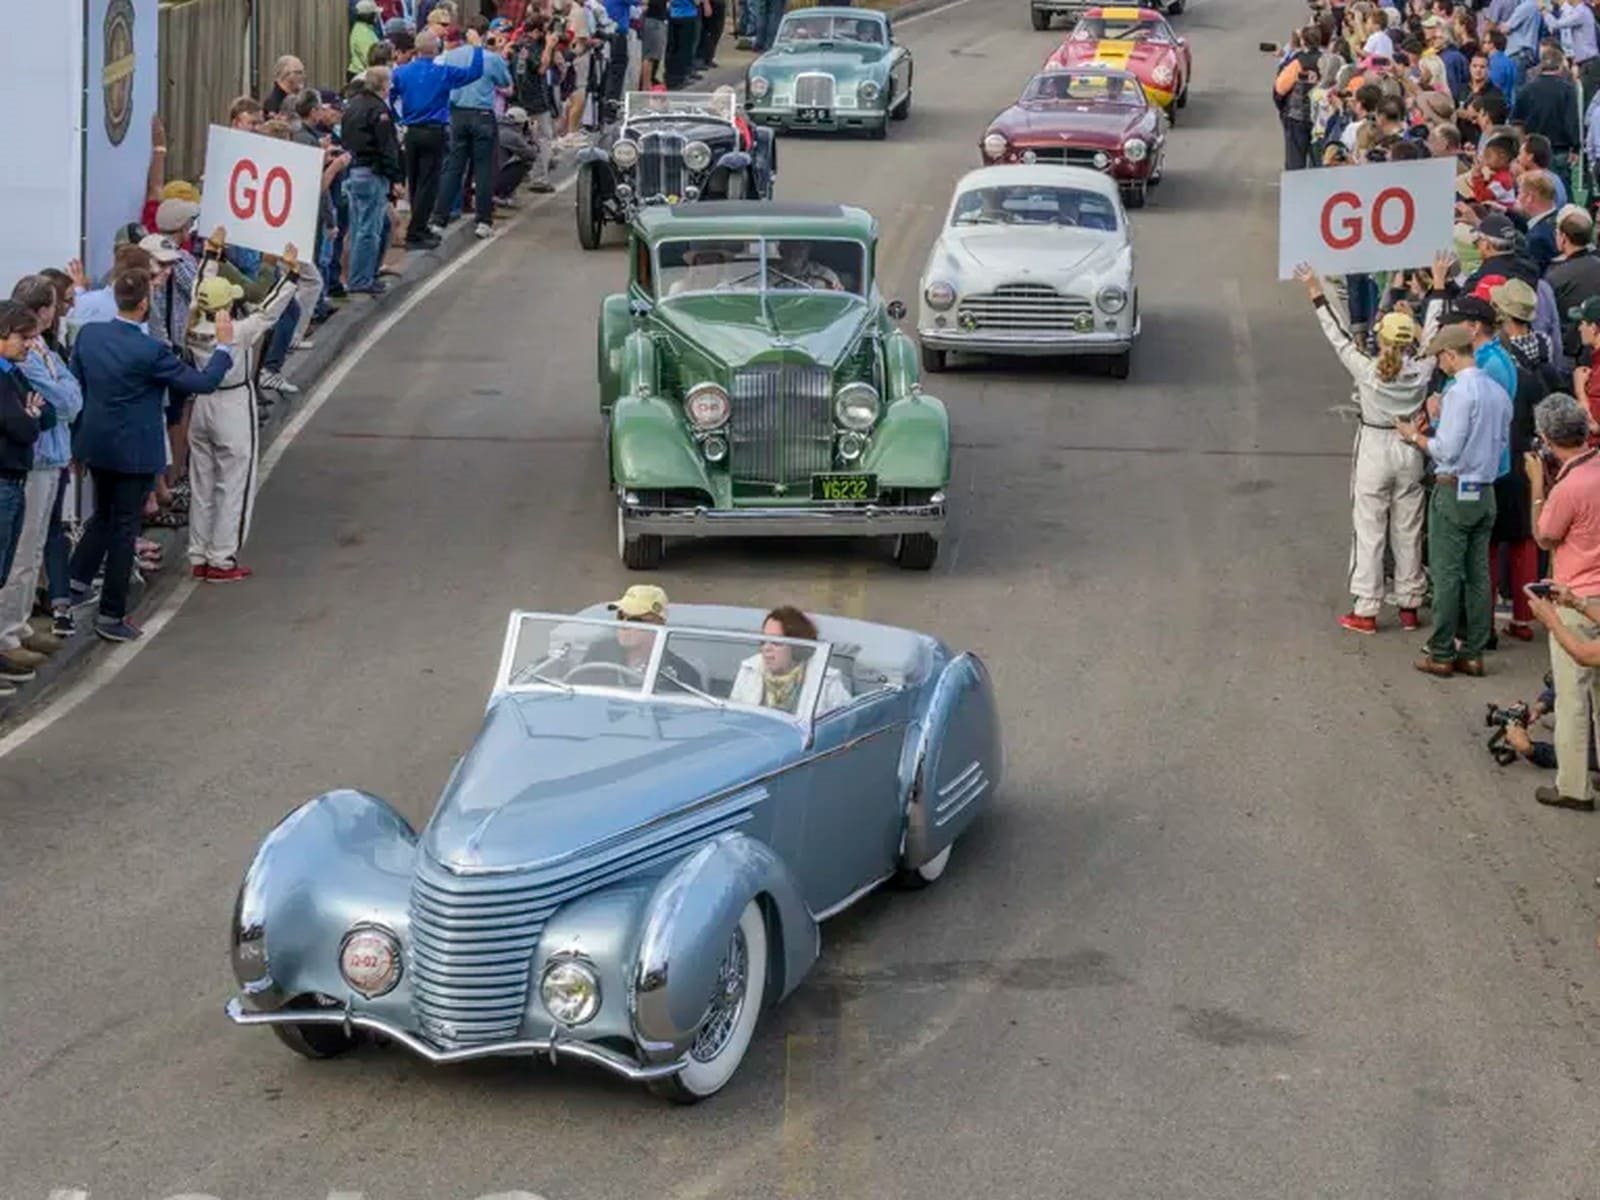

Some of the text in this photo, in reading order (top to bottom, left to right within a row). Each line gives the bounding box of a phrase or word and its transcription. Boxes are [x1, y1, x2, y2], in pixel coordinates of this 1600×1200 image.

[229, 158, 292, 227] GO
[1320, 187, 1415, 250] GO
[822, 480, 868, 499] V6232
